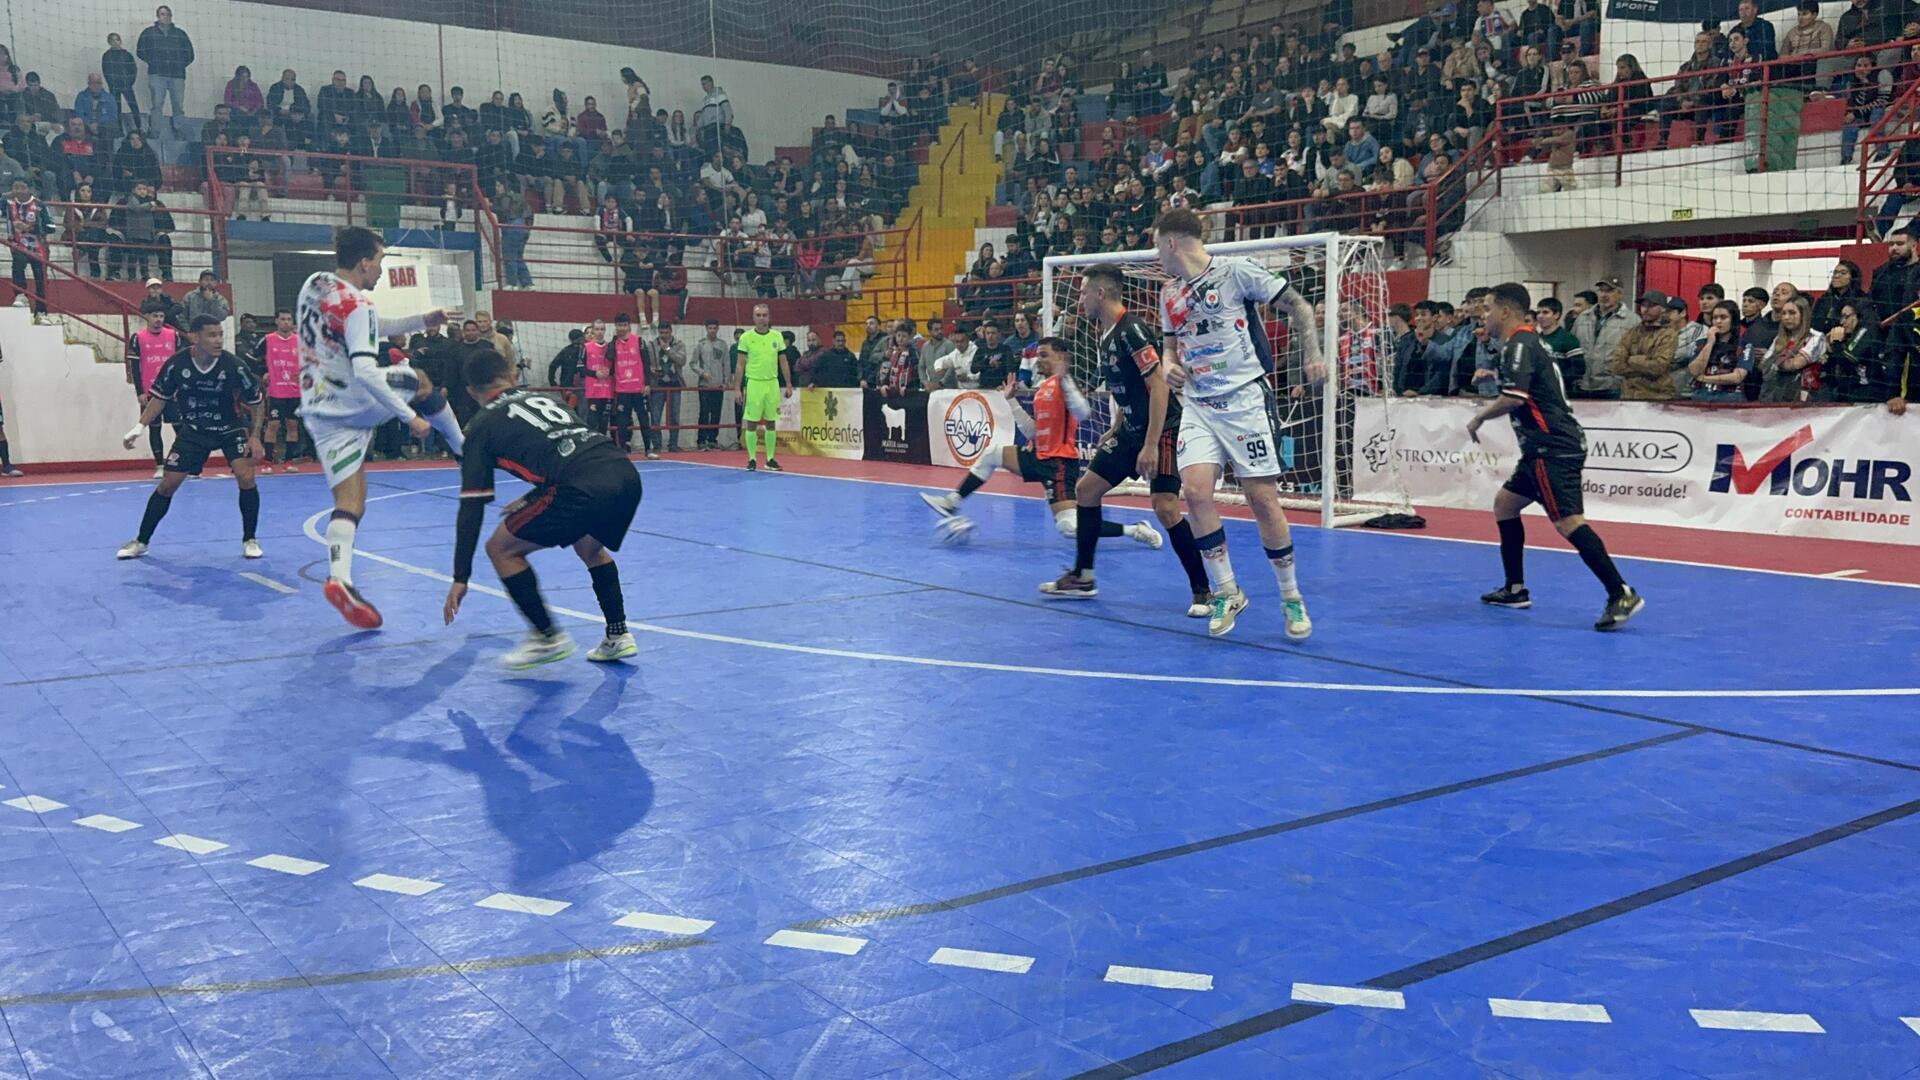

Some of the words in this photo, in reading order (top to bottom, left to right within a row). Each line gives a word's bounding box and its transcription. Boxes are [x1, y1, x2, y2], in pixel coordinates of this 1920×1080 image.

[1615, 2, 1657, 12] SPORTS
[388, 266, 417, 288] BAR
[507, 396, 572, 432] 18
[801, 422, 864, 443] medcenter
[944, 418, 993, 439] GAMA
[1246, 439, 1268, 460] 99
[1395, 449, 1501, 466] STRONGWAY
[1708, 424, 1912, 502] MOHR
[1609, 484, 1635, 498] por
[1637, 483, 1687, 499] saúde!
[1784, 508, 1910, 526] CONTABILIDADE
